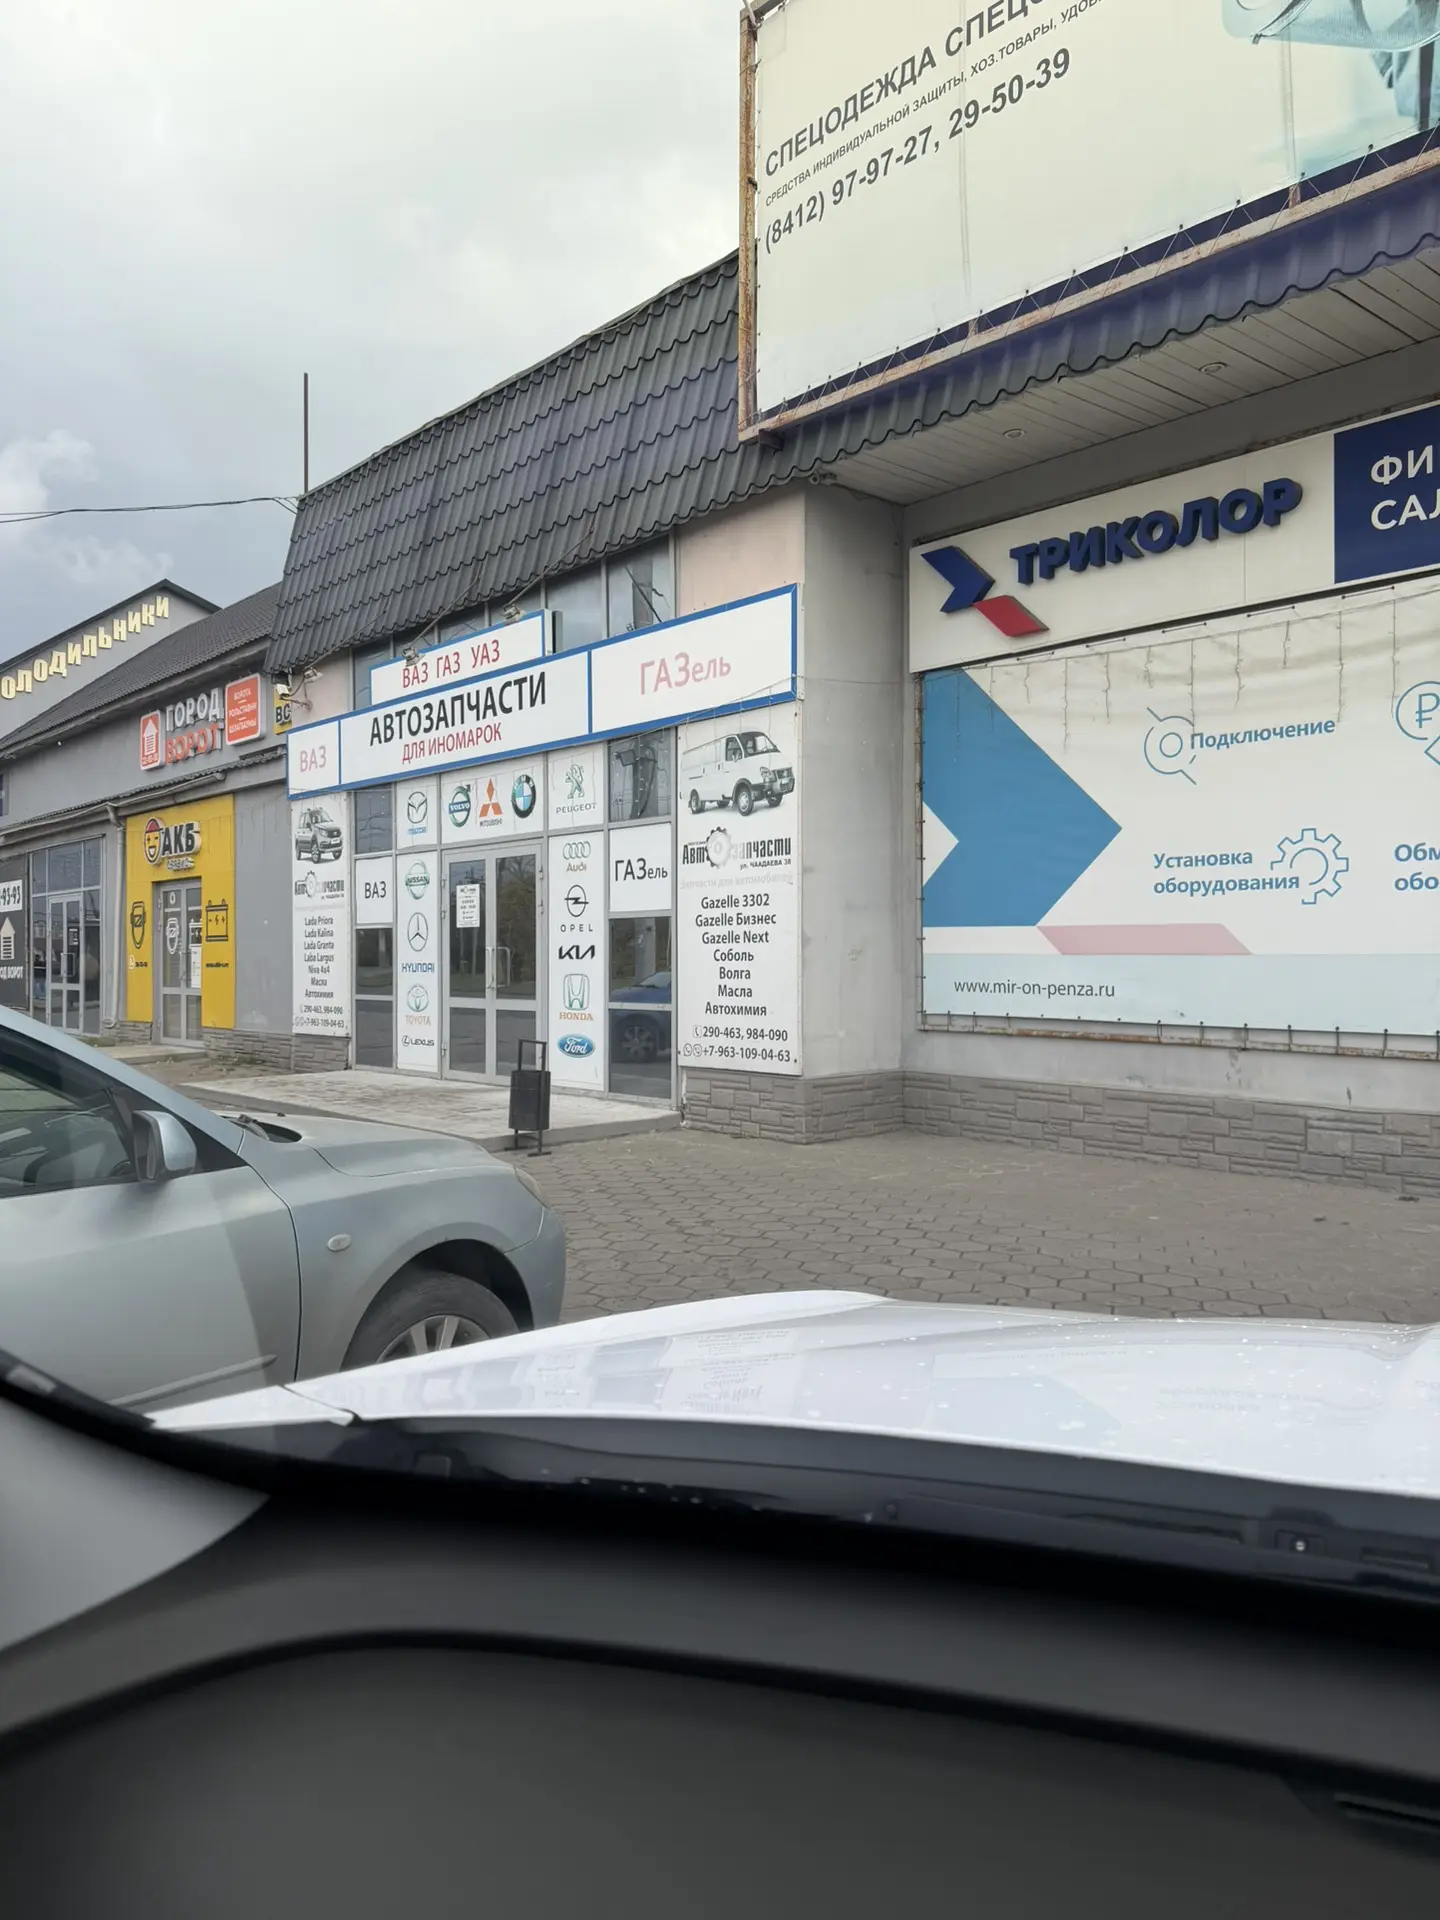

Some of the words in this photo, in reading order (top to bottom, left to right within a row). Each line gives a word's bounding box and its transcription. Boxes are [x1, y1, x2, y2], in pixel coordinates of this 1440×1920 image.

[766, 46, 937, 177] СПЕЦОДЕЖДА
[945, 0, 1042, 57] СПЕЦ
[766, 169, 811, 206] СРЕДСТВА
[813, 103, 910, 174] ИНДИВИДУАЛЬНОЙ
[912, 72, 967, 112] ЗАЩИТЫ,
[970, 19, 1057, 77] ХОЗ.ТОВАРЫ,
[1061, 0, 1102, 23] УДО
[766, 191, 825, 254] (8412)
[832, 125, 939, 205] 97-97-27,
[949, 48, 1070, 139] 29-50-39
[1010, 477, 1304, 585] ТРИКОЛОР
[1, 596, 169, 699] ОЛОДИЛЬНИКИ
[403, 663, 428, 688] ВАЗ
[436, 652, 461, 678] ГАЗ
[471, 639, 500, 669] УАЗ
[640, 652, 732, 695] ГАЗель
[166, 688, 224, 731] ГОРОД
[370, 671, 546, 746] АВТОЗАПЧАСТИ
[402, 742, 426, 765] ДЛЯ
[429, 722, 502, 757] ИНОМАРОК
[1191, 718, 1336, 752] Подключение
[166, 723, 224, 765] ВОРОТ
[300, 745, 327, 773] ВАЗ
[450, 802, 470, 811] VOLVO
[556, 803, 597, 814] PEUGEOT
[162, 823, 194, 855] АКБ
[566, 862, 587, 872] Audi
[1154, 849, 1253, 870] Установка
[615, 857, 668, 881] ГАЗель
[406, 875, 429, 885] NISSAN
[1154, 873, 1300, 897] оборудования
[364, 881, 387, 899] ВАЗ
[701, 894, 740, 909] Gazelle
[742, 893, 770, 907] 3302
[560, 924, 593, 932] OPEL
[695, 913, 734, 927] Gazelle
[736, 912, 777, 926] Бизнес
[702, 930, 740, 944] Gazelle
[743, 930, 769, 943] Next
[558, 945, 595, 960] KIA
[713, 948, 754, 962] Соболь
[402, 962, 435, 973] HYUNDAI
[719, 966, 751, 980] Волга
[718, 984, 753, 997] Масла
[954, 977, 1115, 999] www.mir-on-penza.ru
[559, 1011, 594, 1021] HONDA
[705, 1001, 767, 1016] Автохимия
[405, 1015, 431, 1026] TOYOTA
[703, 1026, 744, 1041] 290-463,
[746, 1028, 788, 1041] 984-090
[411, 1038, 435, 1047] LEXUS
[564, 1037, 588, 1054] Ford
[703, 1045, 791, 1062] +7-963-109-04-63
